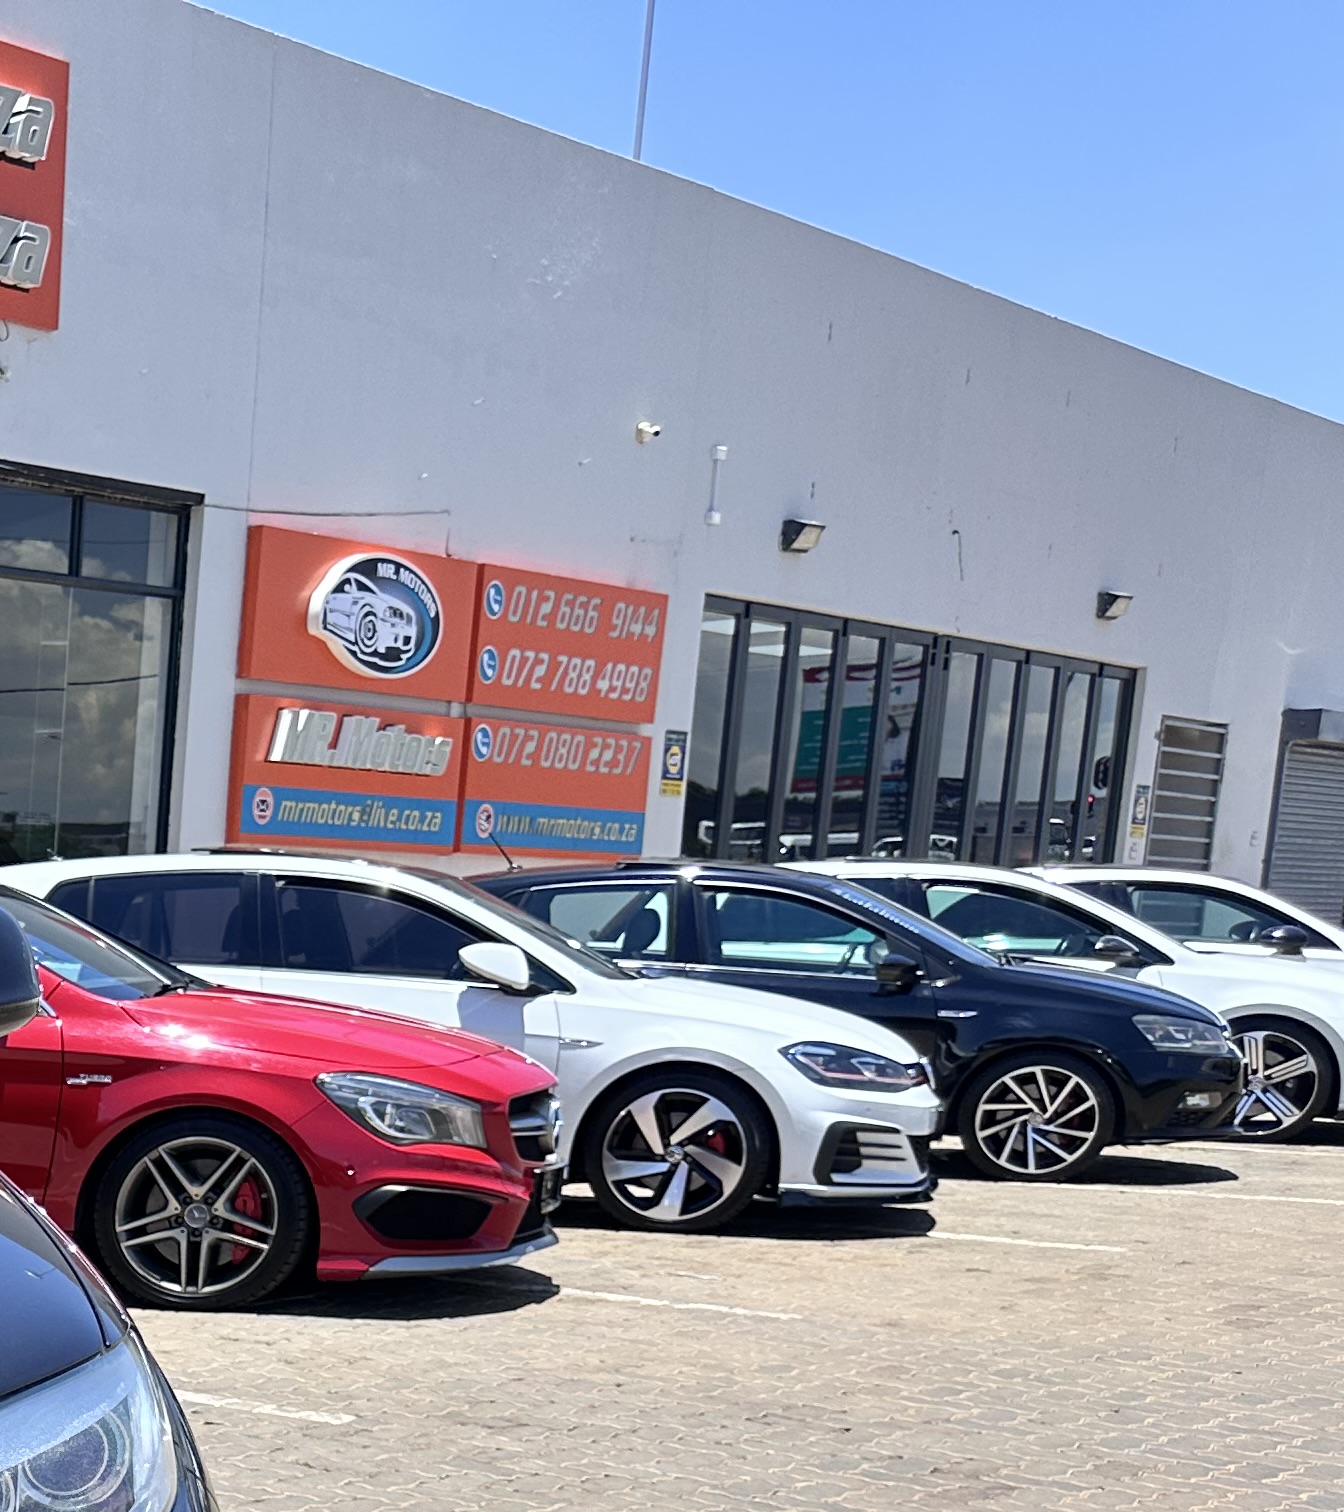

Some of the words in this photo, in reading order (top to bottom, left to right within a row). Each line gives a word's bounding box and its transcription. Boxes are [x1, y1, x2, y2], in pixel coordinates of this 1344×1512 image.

[398, 568, 436, 618] MOTORS
[507, 585, 556, 627] 012
[556, 593, 603, 634] 666
[608, 602, 660, 643] 9144
[501, 648, 550, 690] 072
[550, 655, 596, 696] 788
[596, 662, 653, 702] 4998
[336, 714, 453, 777] Motors
[492, 726, 540, 767] 072
[540, 731, 586, 770] 080
[585, 737, 642, 776] 2237
[496, 814, 638, 842] www.mrmotors.co.za
